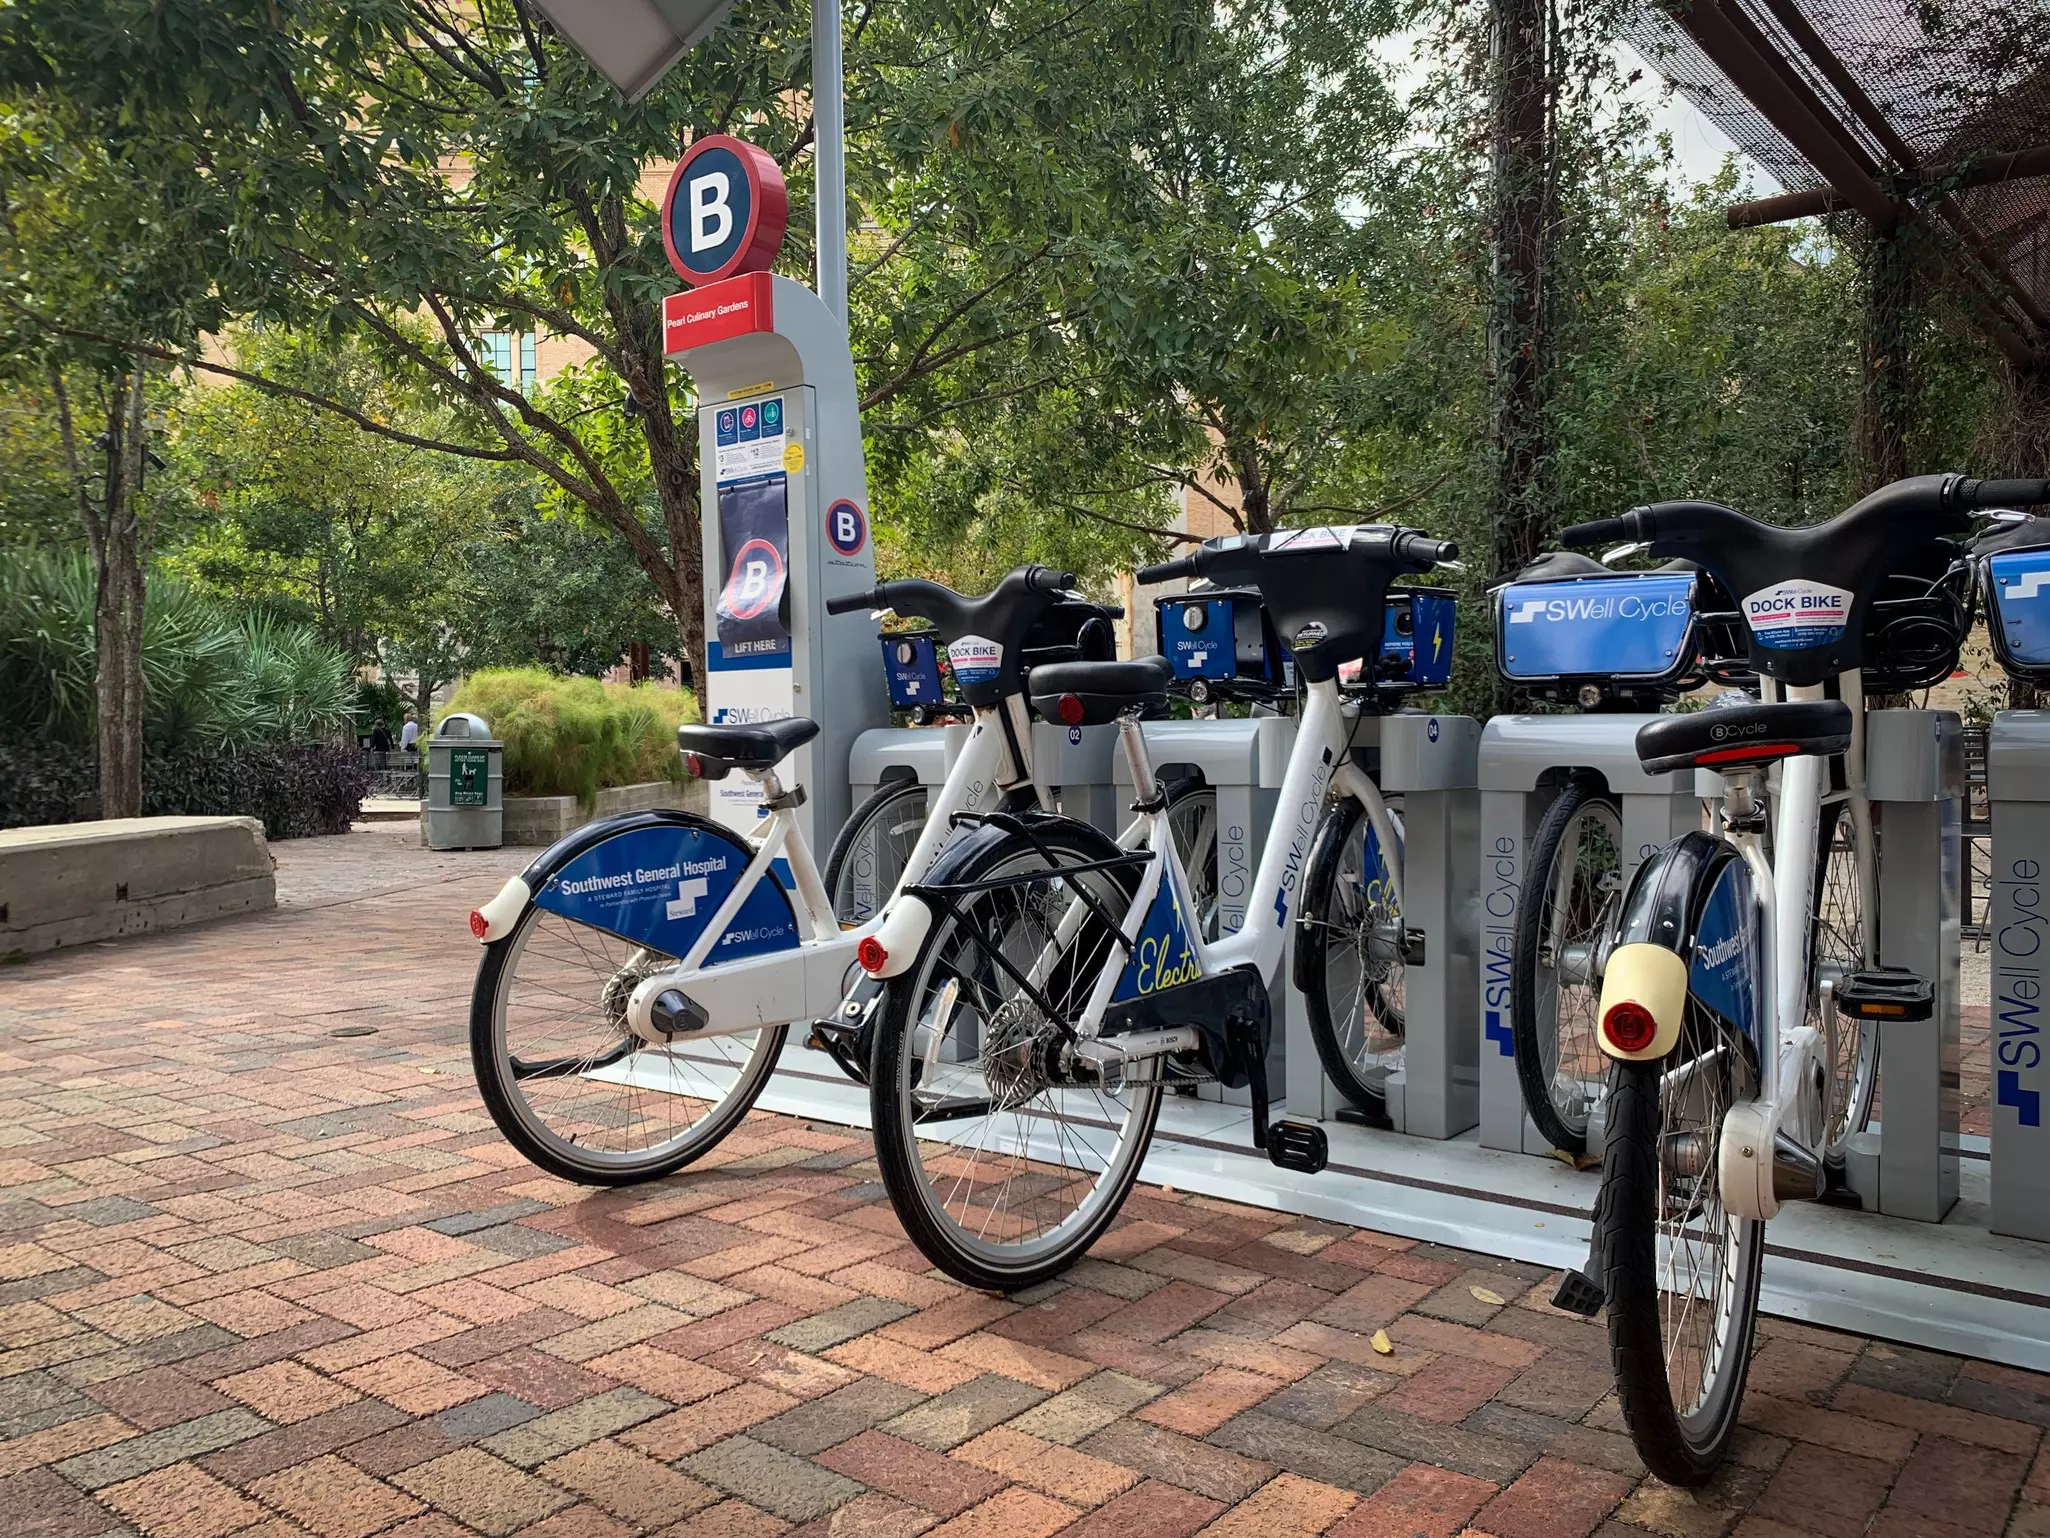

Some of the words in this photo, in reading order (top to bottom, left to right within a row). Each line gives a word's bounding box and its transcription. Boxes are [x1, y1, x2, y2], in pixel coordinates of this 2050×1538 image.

[690, 171, 733, 253] B
[667, 314, 686, 329] Pearl
[686, 309, 716, 325] Culinary
[717, 300, 748, 315] Gardens
[836, 511, 856, 542] B
[740, 560, 768, 599] B
[1546, 596, 1615, 622] SWell
[1618, 594, 1687, 622] Cycle
[1751, 597, 1796, 613] DOCK
[1801, 595, 1842, 608] BIKE
[735, 642, 752, 653] LIFT
[753, 639, 777, 652] HERE
[951, 647, 971, 657] DOCK
[972, 646, 996, 656] BIKE
[1197, 640, 1218, 651] Cycle
[729, 707, 759, 724] SWell
[1069, 729, 1080, 740] 02
[1429, 724, 1438, 737] 04
[720, 789, 746, 797] Southwest
[746, 789, 764, 798] Genera
[1282, 824, 1309, 892] SWell
[1301, 766, 1326, 825] Cycle
[1222, 825, 1249, 897] Cycle
[561, 871, 633, 896] Southwest
[635, 863, 681, 884] General
[683, 855, 727, 877] Hospital
[1486, 836, 1520, 918] Cycle
[594, 891, 623, 902] STEWARD
[624, 887, 644, 897] FAMILY
[645, 884, 671, 893] HOSPITAL
[669, 906, 693, 917] Steward
[1998, 858, 2049, 957] Cycle
[734, 928, 759, 943] SWell
[760, 925, 784, 940] Cycle
[1702, 930, 1742, 971] Southwest
[1486, 925, 1515, 1009] SWell
[1998, 967, 2040, 1069] SWell
[1165, 1036, 1178, 1045] BOSCH
